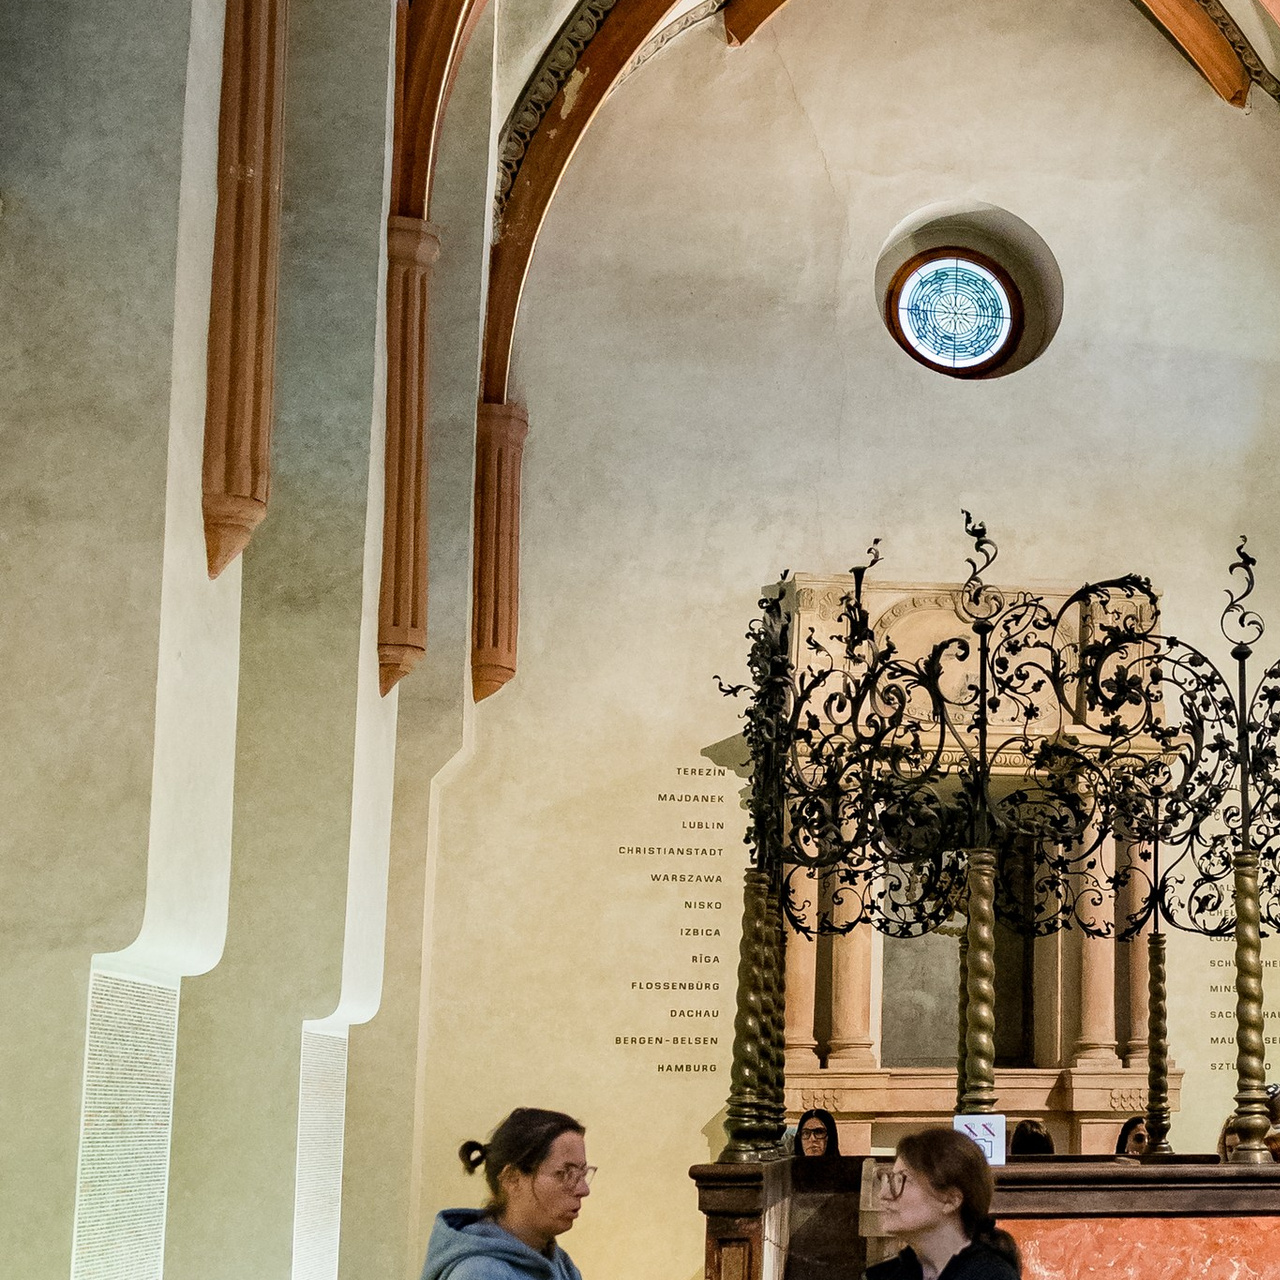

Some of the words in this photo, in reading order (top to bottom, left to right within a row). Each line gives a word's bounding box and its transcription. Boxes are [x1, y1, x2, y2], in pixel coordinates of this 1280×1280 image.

[676, 766, 726, 777] TEREZÍN
[657, 793, 725, 803] MAJDANEK
[681, 820, 725, 830] LUBLIN
[618, 846, 724, 857] CHRISTIANSTADT
[650, 873, 723, 884] WARSZAWA
[684, 900, 723, 910] NISKO
[680, 927, 721, 937] IZBICA
[631, 980, 720, 991] FLOSSENBÜRG
[1209, 985, 1238, 993] MINS
[669, 1009, 720, 1020] DACHAU
[614, 1036, 719, 1046] BERGEN-BELSEN
[657, 1063, 717, 1073] HAMBURG
